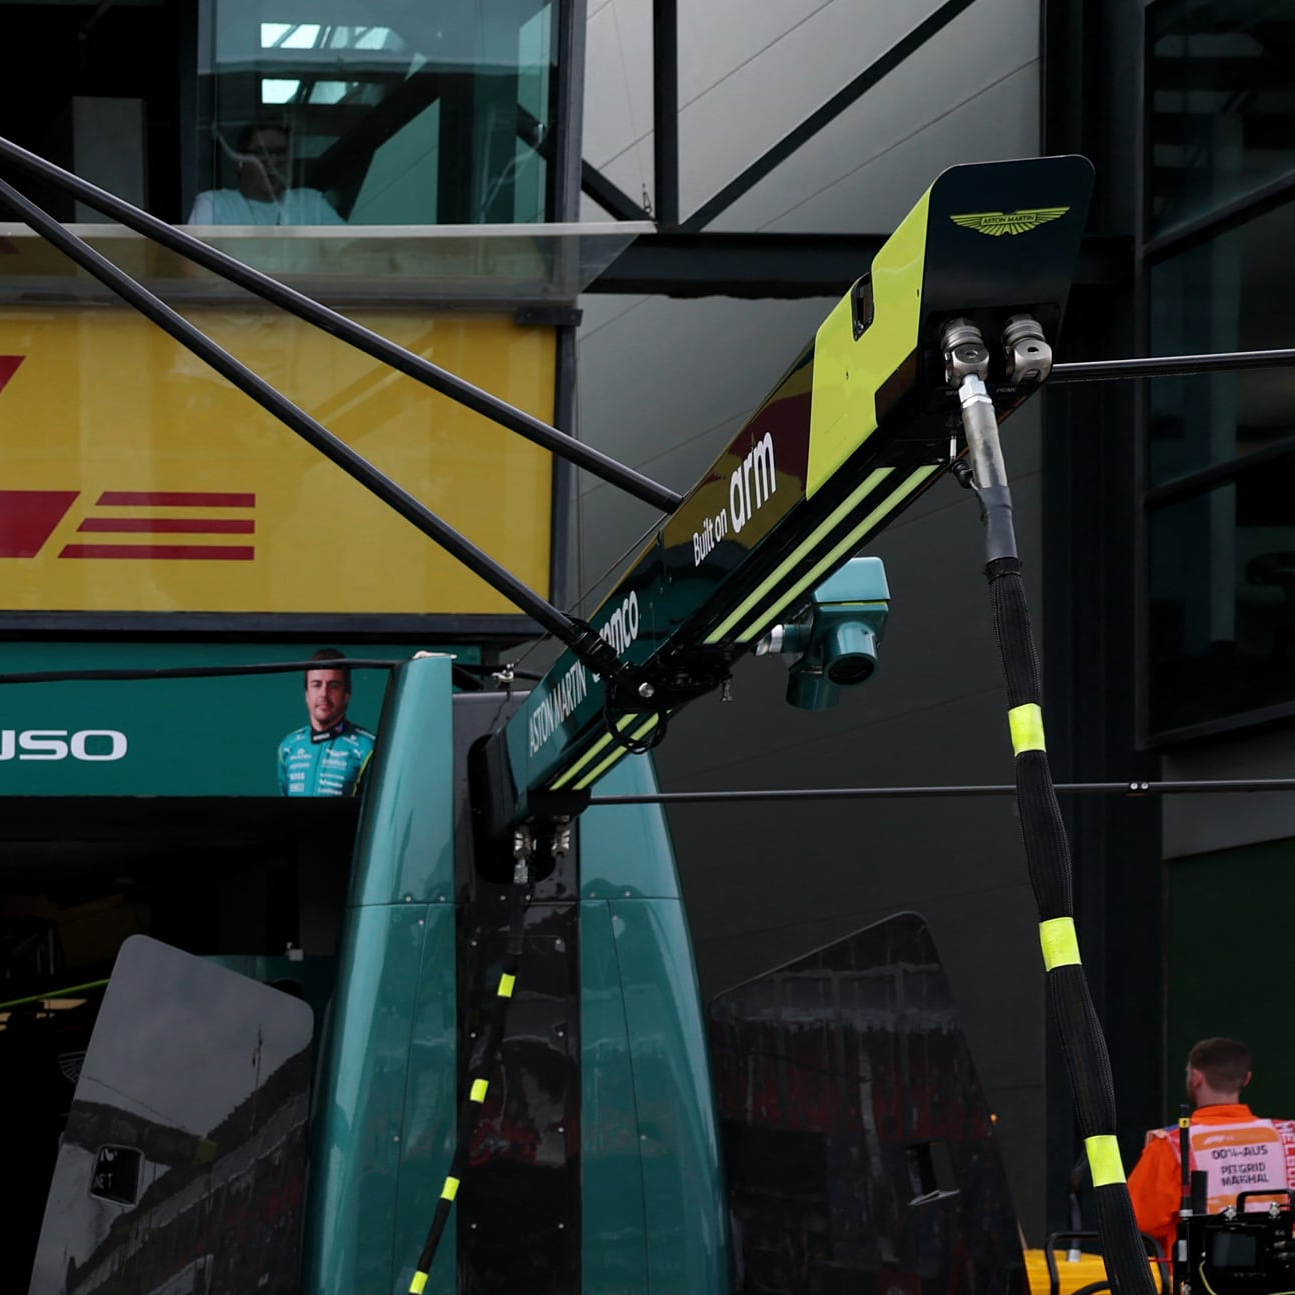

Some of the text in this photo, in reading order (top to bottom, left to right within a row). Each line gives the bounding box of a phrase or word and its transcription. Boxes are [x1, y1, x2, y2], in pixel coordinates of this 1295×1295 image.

[692, 432, 777, 568] Built on arm
